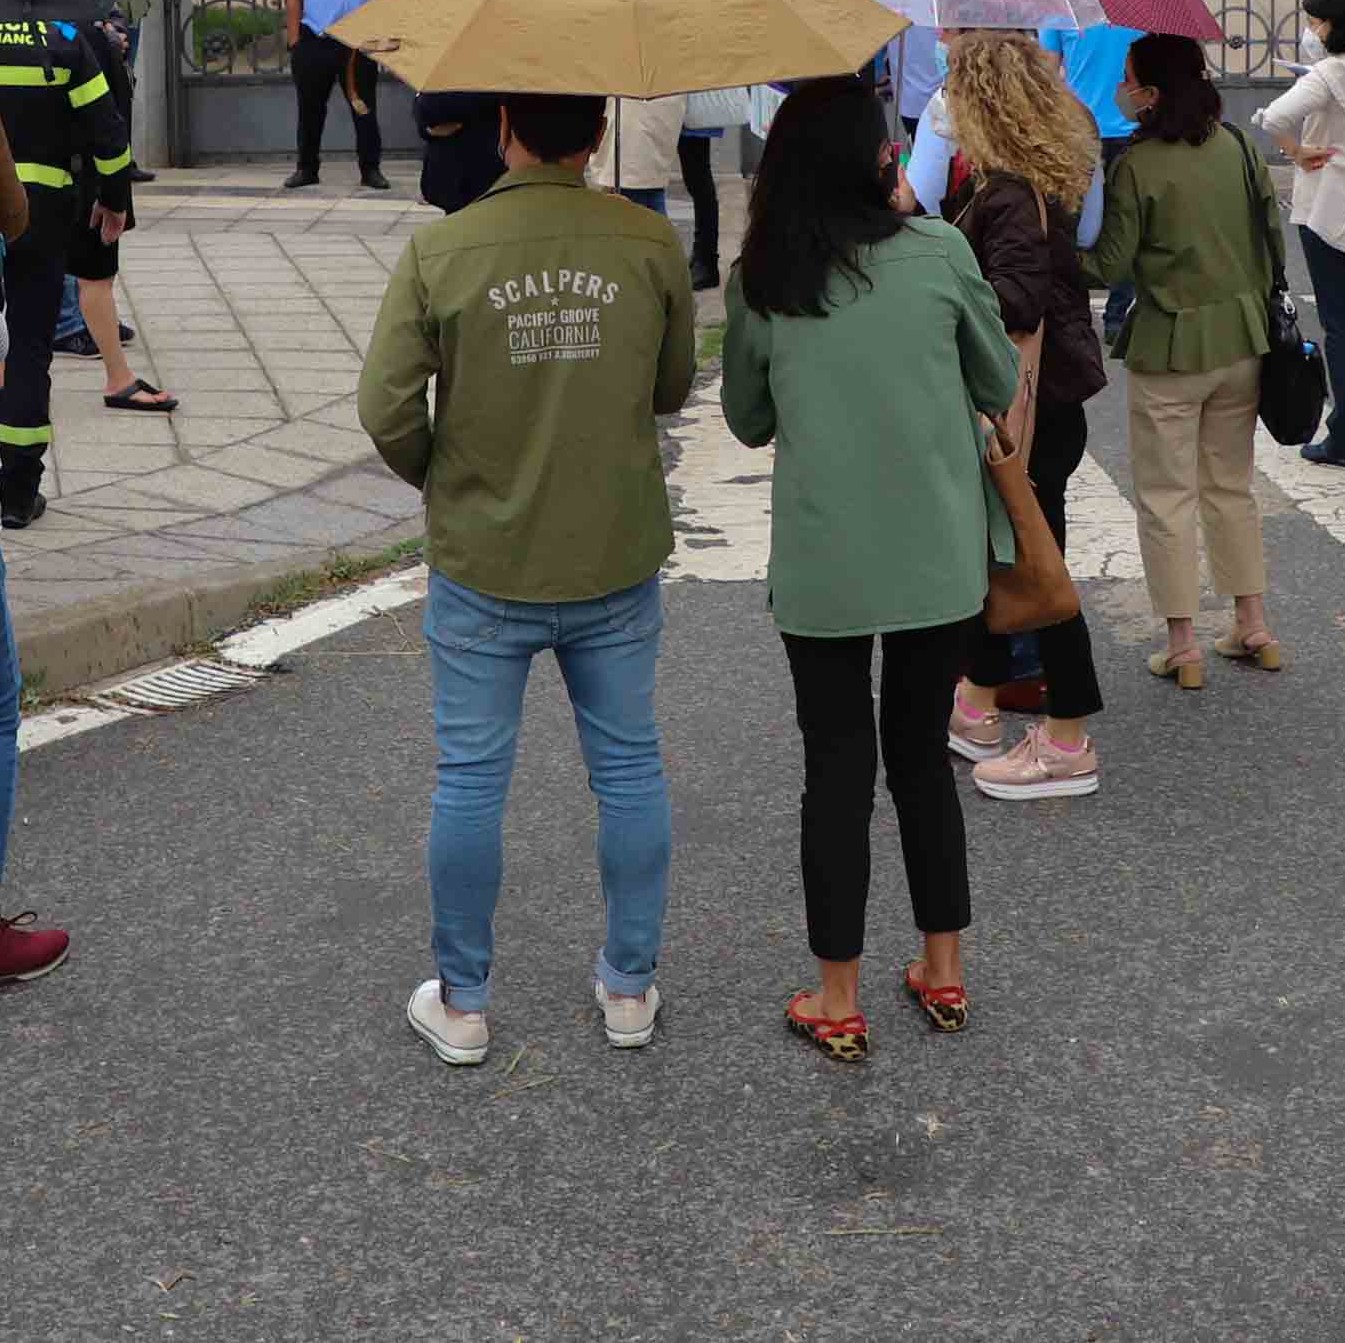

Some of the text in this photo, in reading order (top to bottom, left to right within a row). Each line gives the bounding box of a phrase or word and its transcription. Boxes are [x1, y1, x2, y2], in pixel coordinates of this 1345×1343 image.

[488, 269, 620, 310] SCALPERS
[508, 308, 600, 329] PACIFIC GROVE
[509, 324, 601, 350] CALIFORNIA
